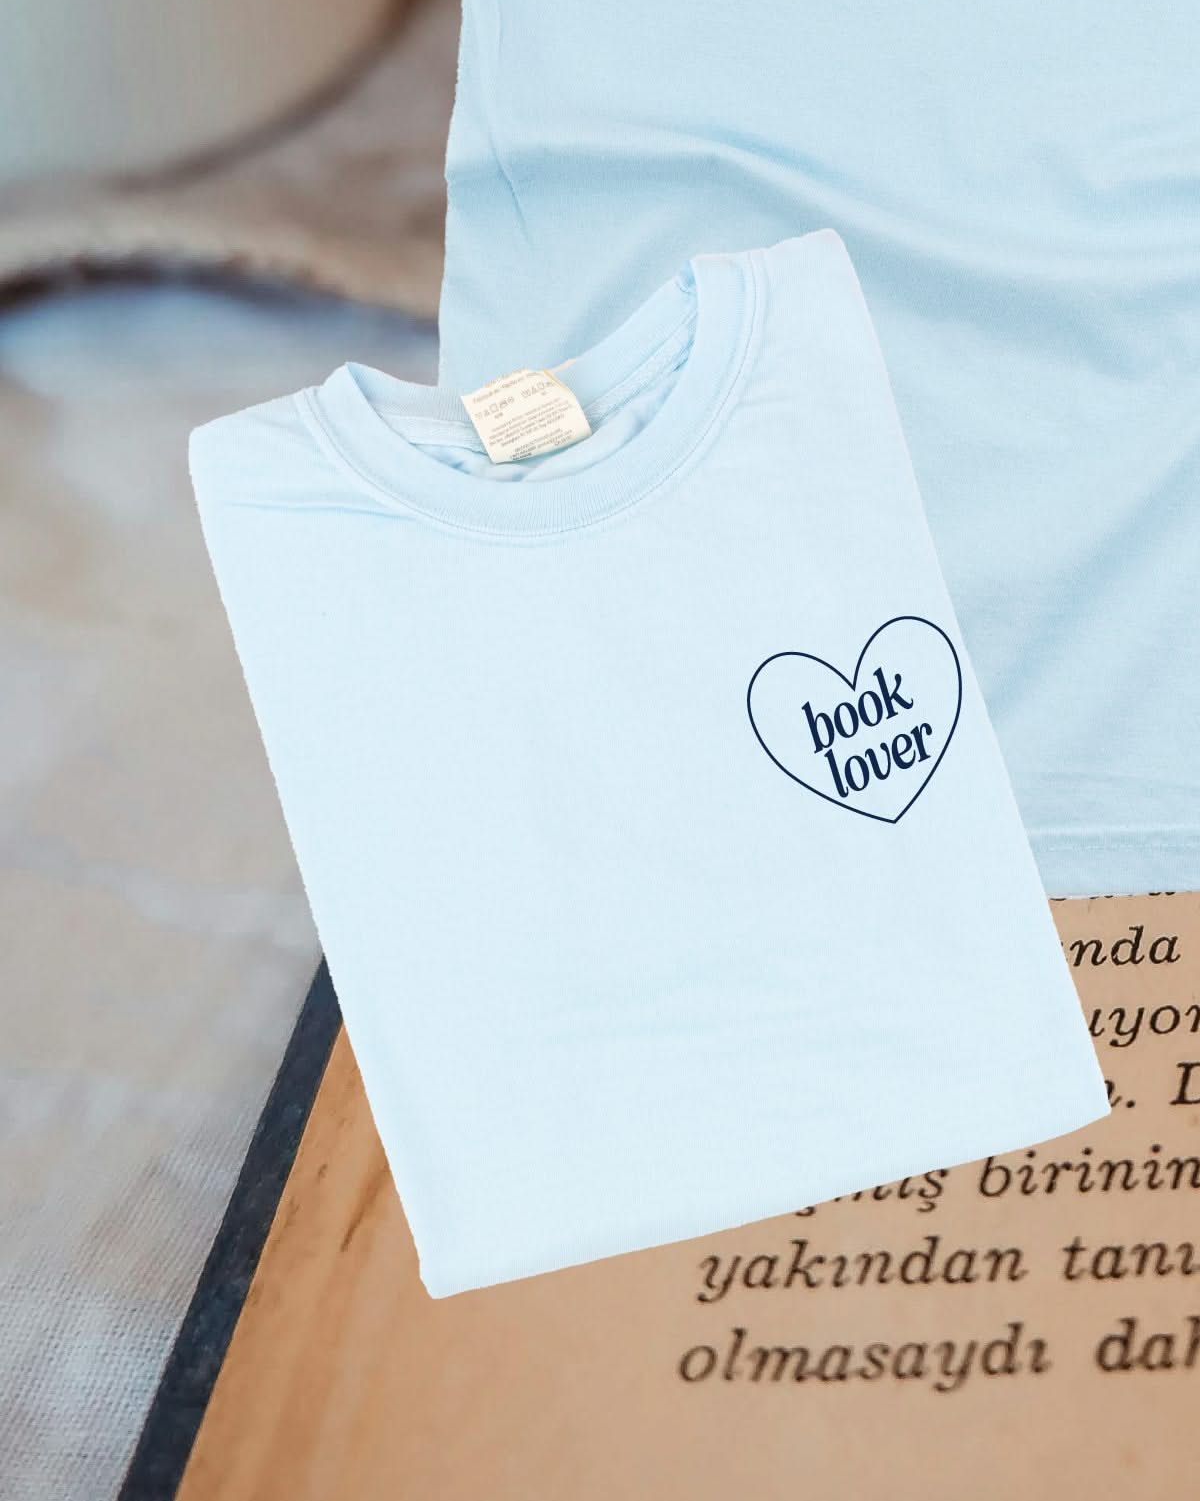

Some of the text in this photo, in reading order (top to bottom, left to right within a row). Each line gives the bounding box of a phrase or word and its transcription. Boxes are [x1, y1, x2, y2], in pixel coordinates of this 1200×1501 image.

[801, 666, 914, 755] book
[824, 722, 933, 798] lover
[1060, 924, 1182, 968] nda
[695, 1234, 1031, 1304] yakından
[677, 1320, 1054, 1394] olmasaydı
